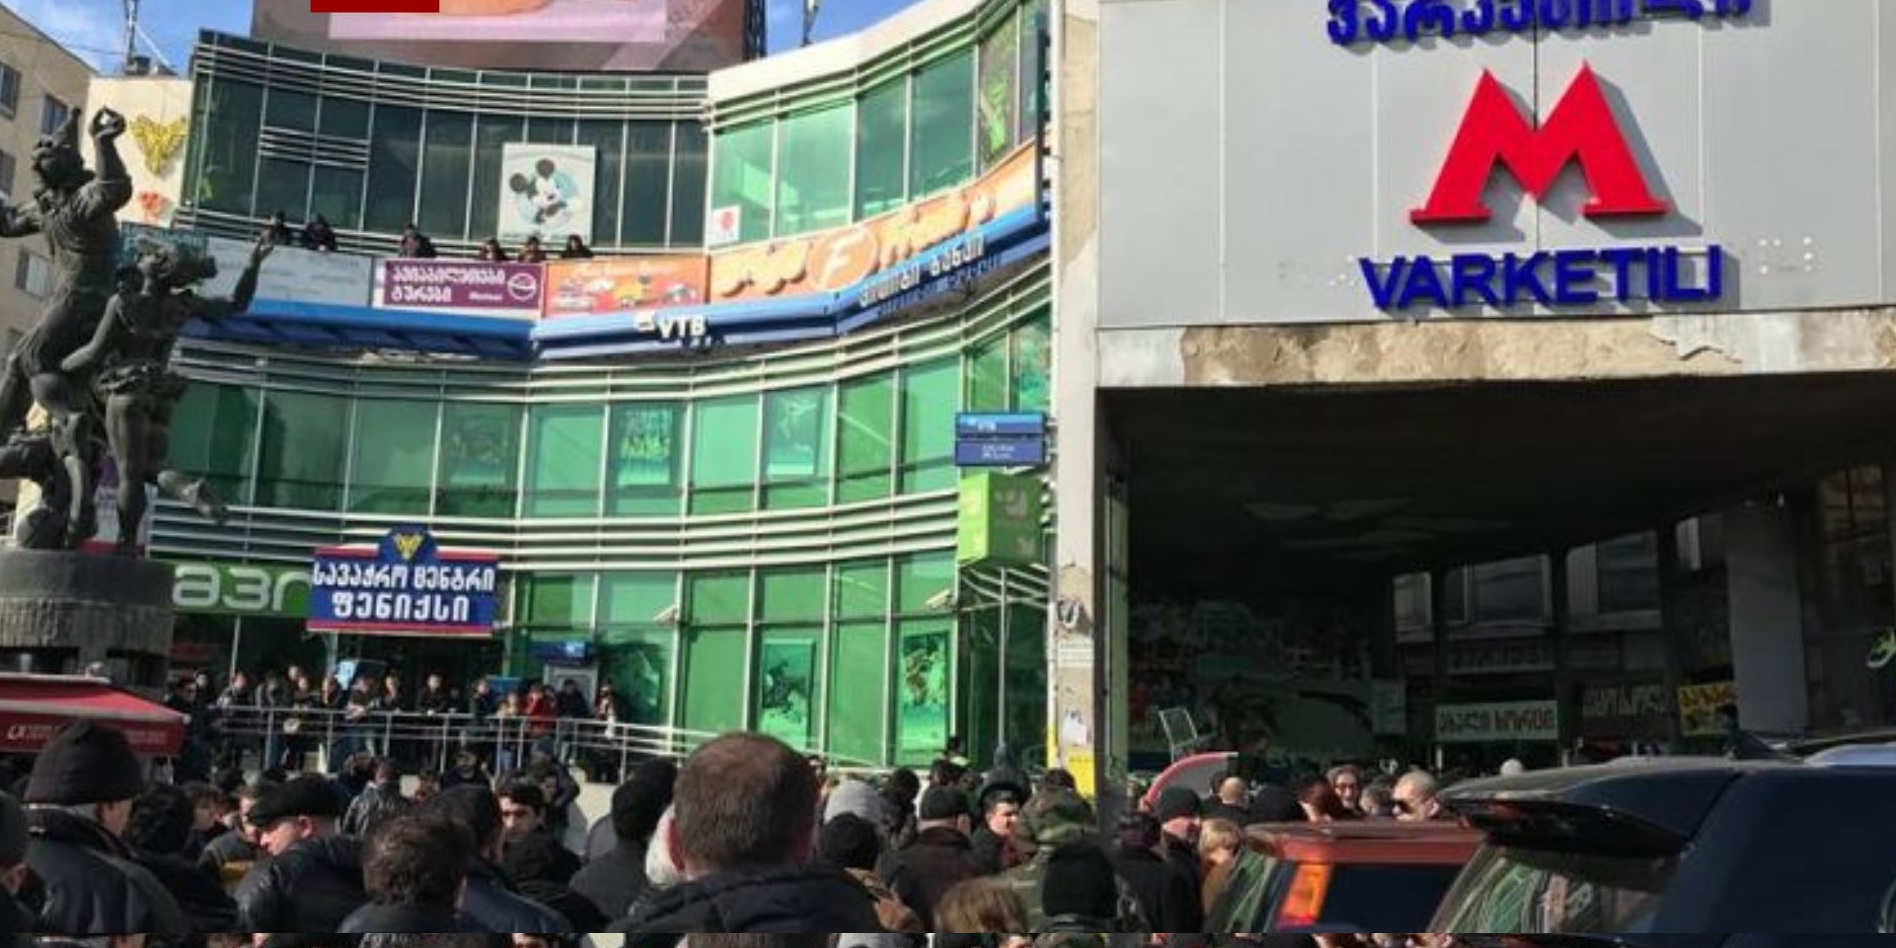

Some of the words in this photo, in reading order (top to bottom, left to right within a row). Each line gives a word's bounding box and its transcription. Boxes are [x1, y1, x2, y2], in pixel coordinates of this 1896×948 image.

[1410, 60, 1671, 224] M
[1359, 245, 1722, 311] VARKETILI
[658, 314, 706, 338] VTB
[312, 561, 408, 590] სავაჭრო
[413, 564, 496, 592] ცენტრი
[331, 590, 470, 623] ფენიქსი
